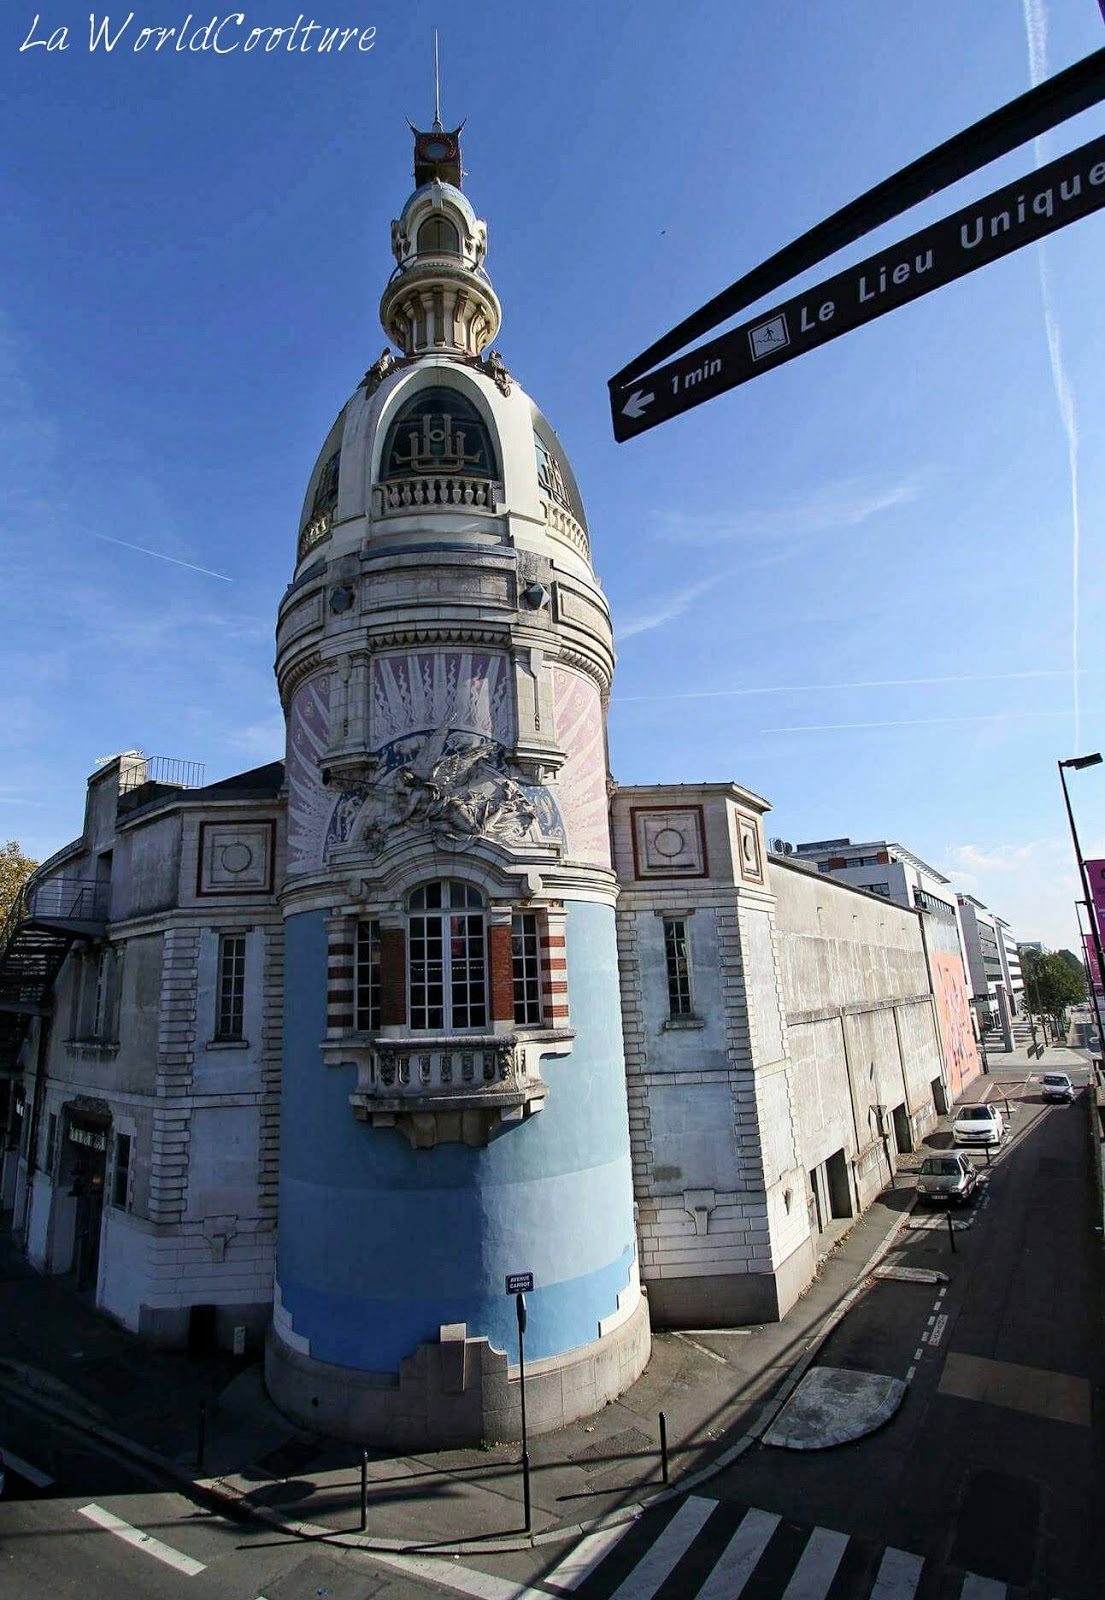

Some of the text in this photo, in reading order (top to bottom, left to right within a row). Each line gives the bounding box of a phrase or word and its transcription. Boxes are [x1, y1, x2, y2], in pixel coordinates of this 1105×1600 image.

[671, 161, 1105, 395] 1 min Le Lieu Unique
